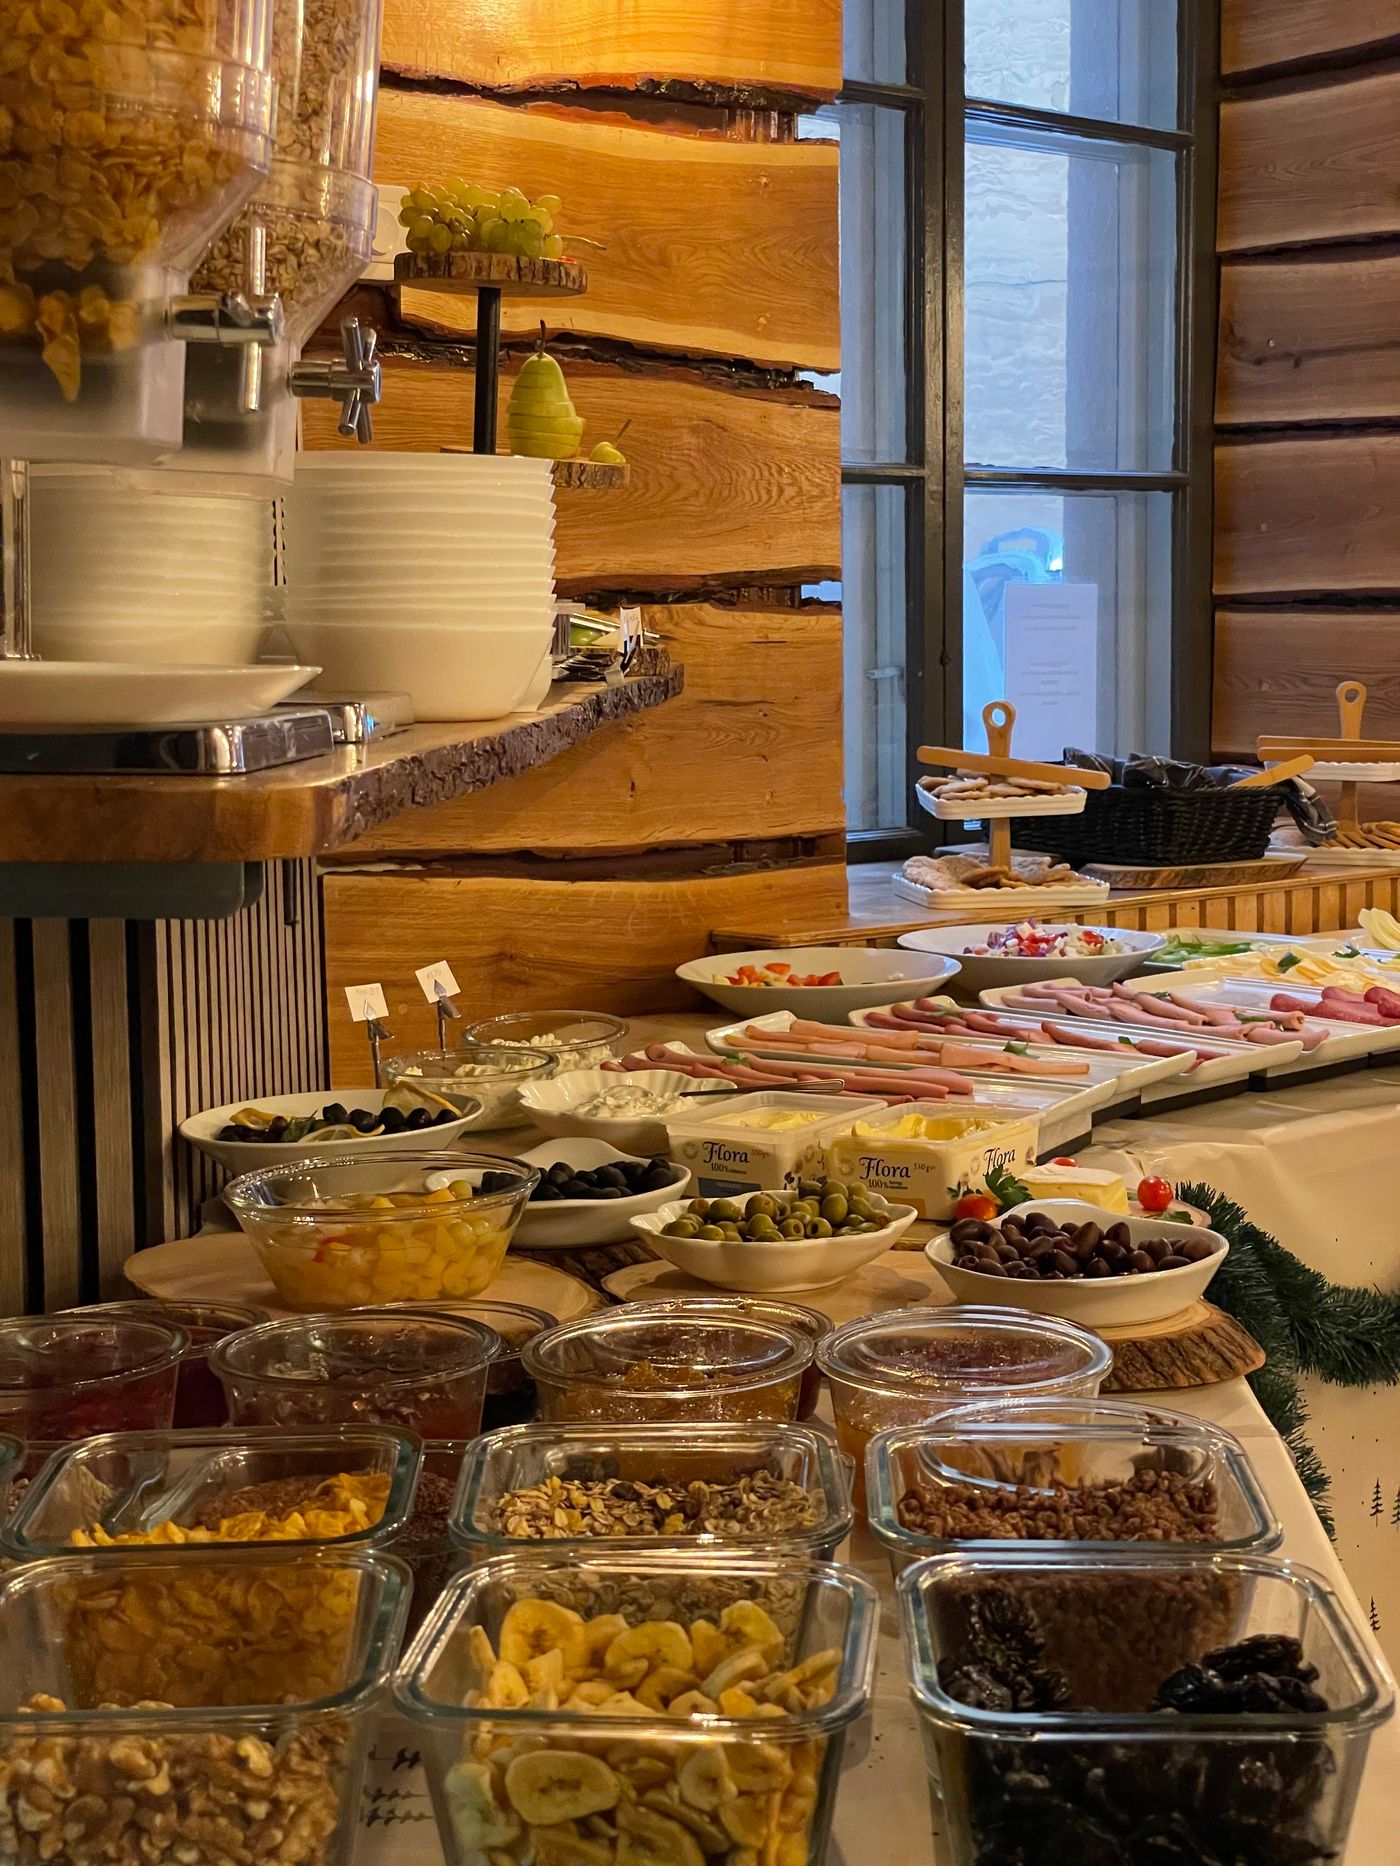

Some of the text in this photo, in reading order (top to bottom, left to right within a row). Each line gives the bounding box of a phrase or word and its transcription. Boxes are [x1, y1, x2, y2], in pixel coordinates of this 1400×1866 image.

[702, 1142, 750, 1164] Flora
[982, 1147, 1016, 1177] Flora
[859, 1156, 912, 1180] Flora
